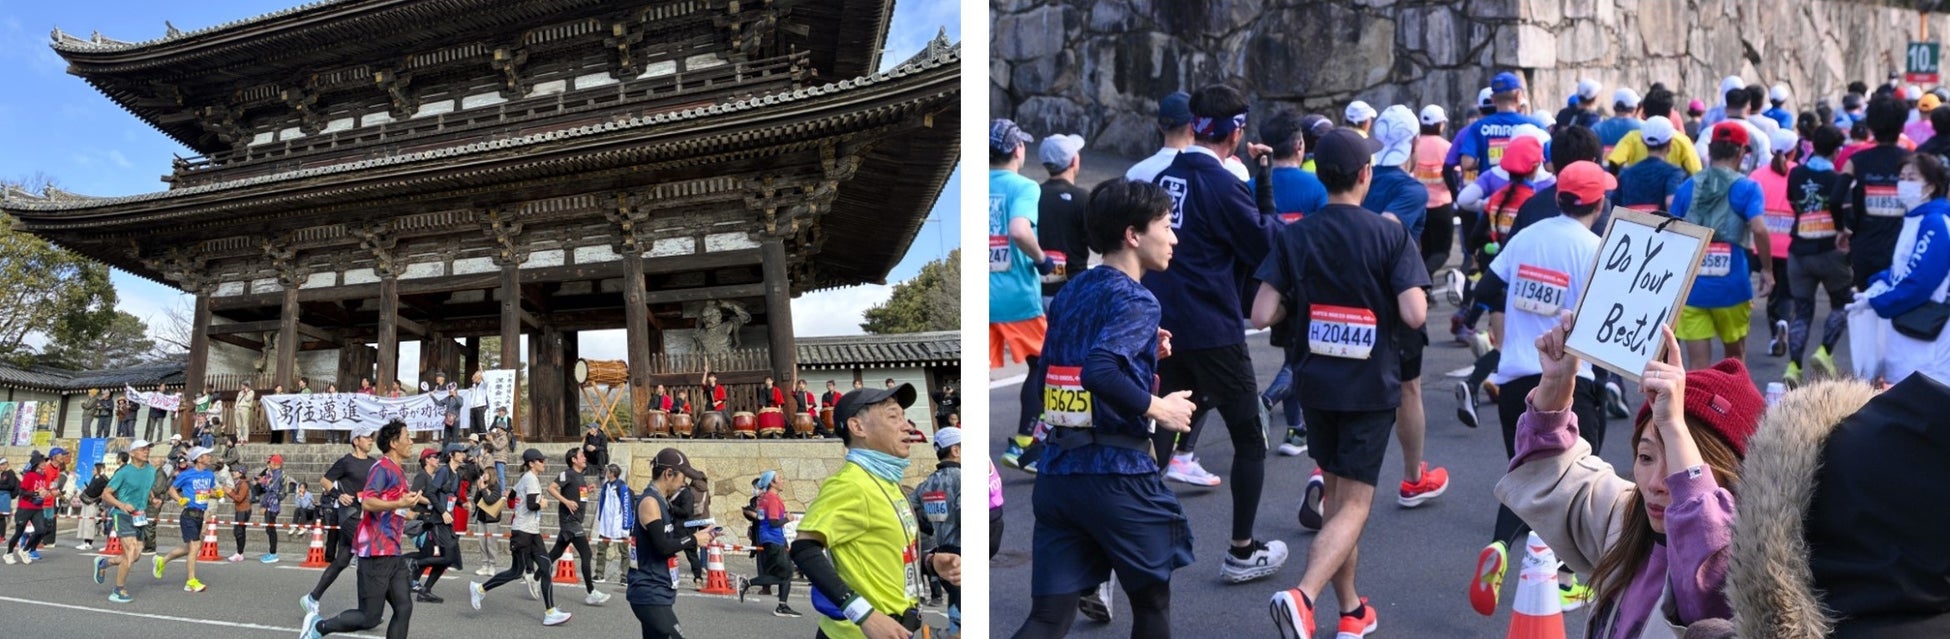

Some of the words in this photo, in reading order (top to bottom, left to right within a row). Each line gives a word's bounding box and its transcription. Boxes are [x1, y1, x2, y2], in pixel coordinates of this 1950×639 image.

[1909, 44, 1930, 71] 10
[1605, 234, 1632, 273] Do
[1628, 236, 1673, 294] Your
[1596, 303, 1667, 355] Best!
[277, 399, 363, 425] 勇往邁進
